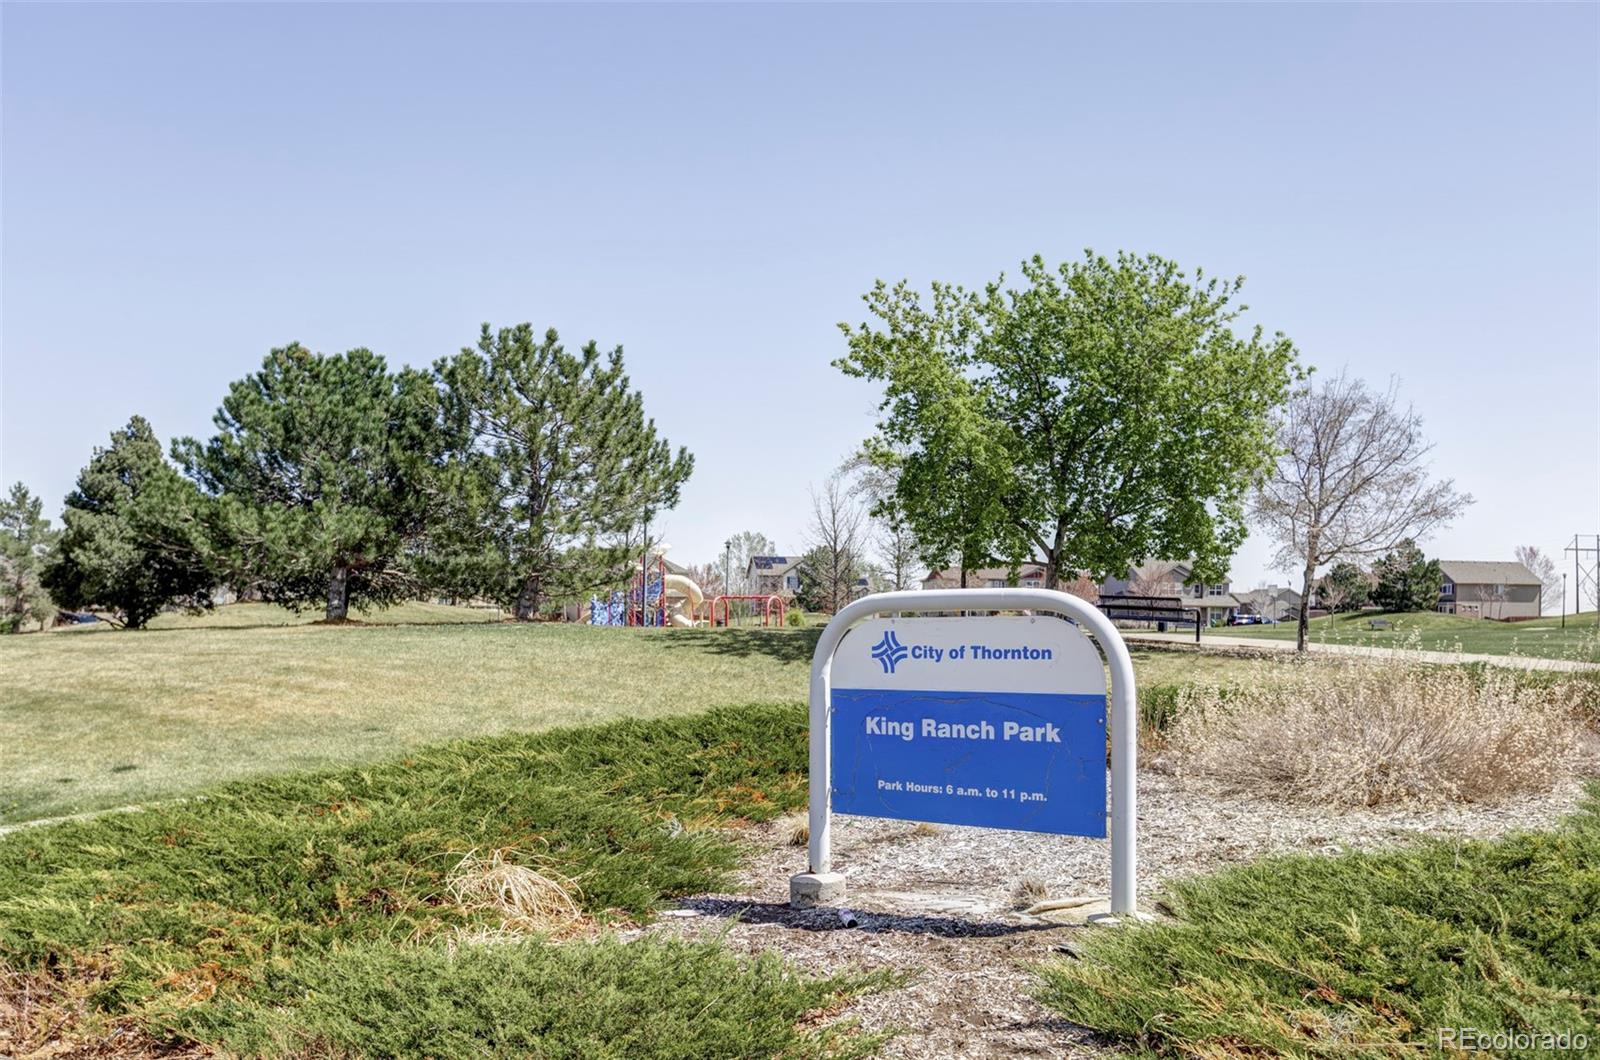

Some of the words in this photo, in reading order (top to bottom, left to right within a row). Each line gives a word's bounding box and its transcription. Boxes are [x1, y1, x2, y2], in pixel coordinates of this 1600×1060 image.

[912, 645, 944, 662] City
[949, 645, 966, 660] of
[971, 645, 1052, 660] Thornton
[866, 717, 914, 740] King
[922, 718, 995, 740] Ranch
[1004, 721, 1062, 743] Park
[878, 780, 903, 792] Park
[906, 782, 943, 794] Hours:
[946, 784, 954, 795] 6
[956, 788, 982, 796] a.m.
[986, 788, 998, 798] to
[1002, 788, 1016, 800] 11
[1020, 792, 1048, 802] p.m.
